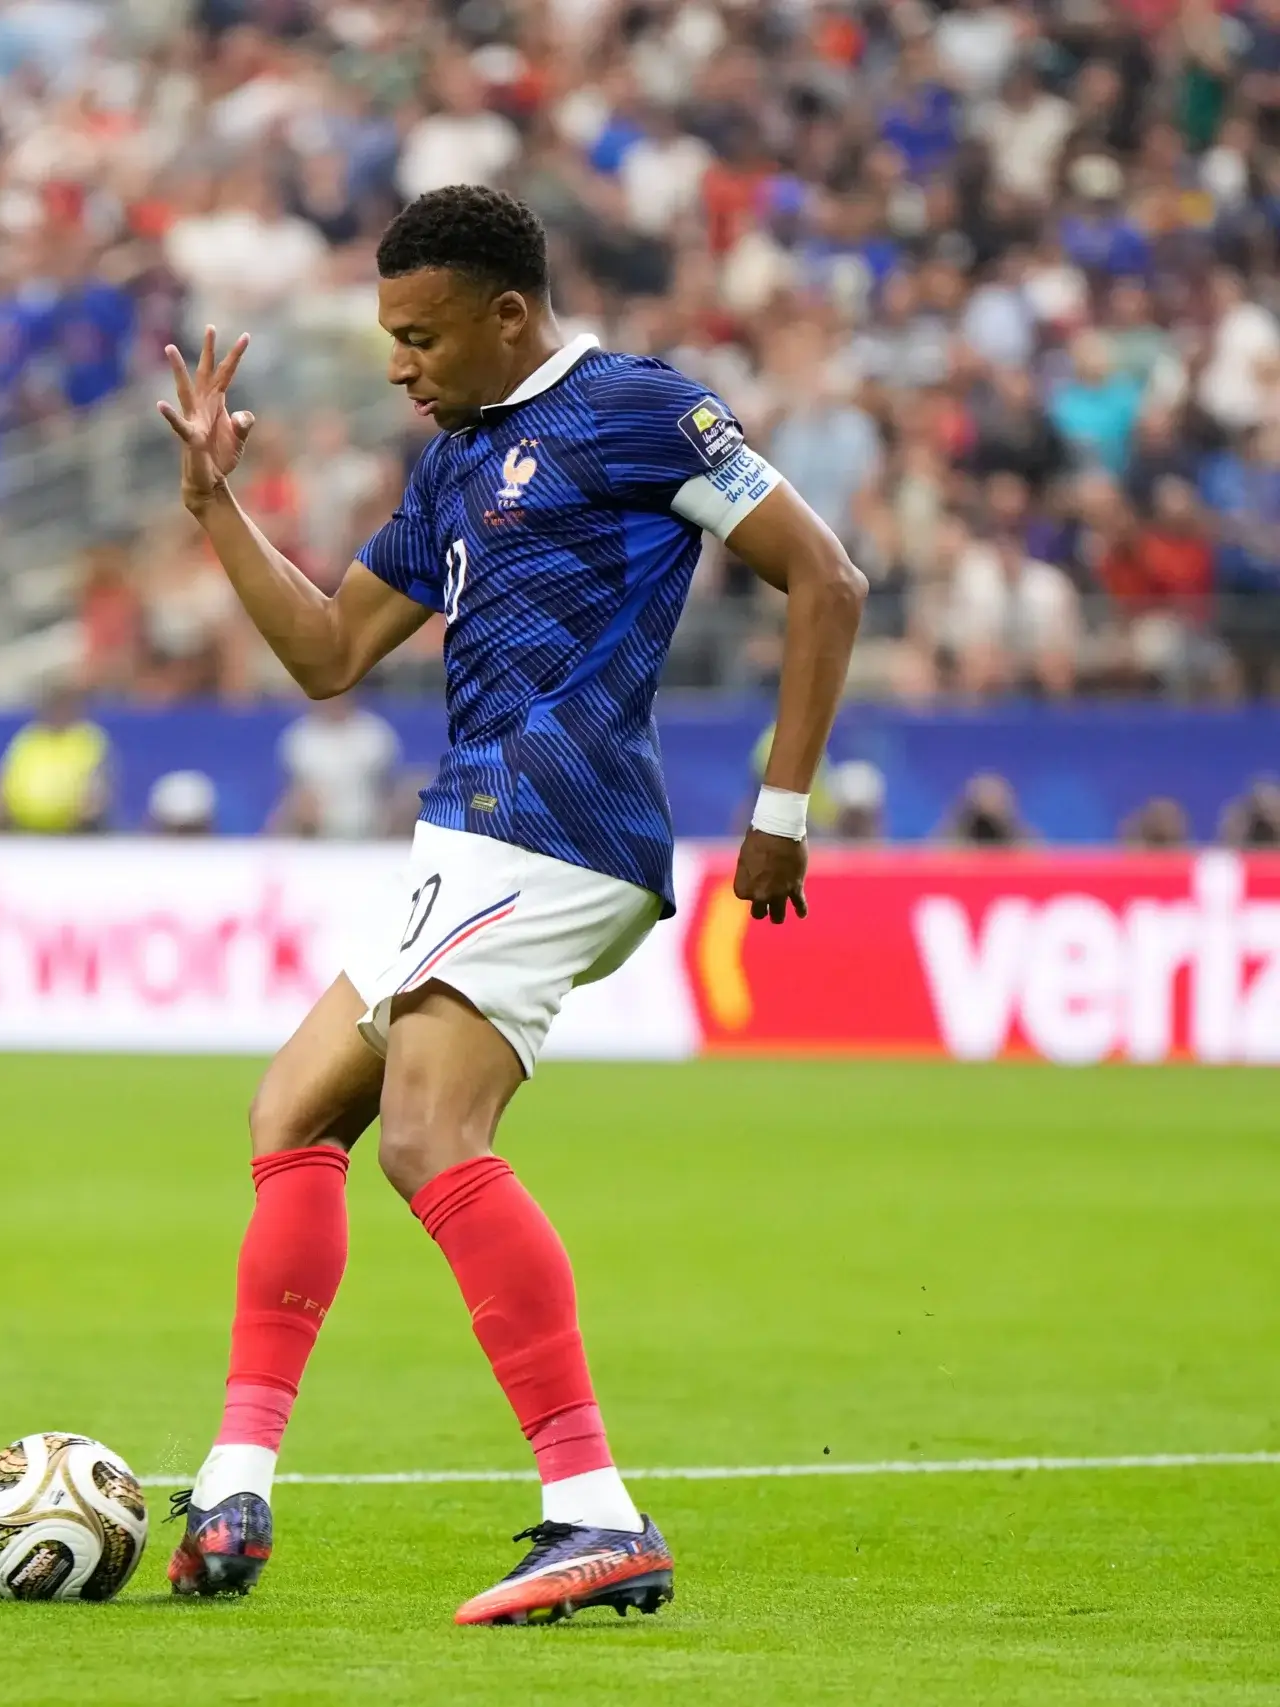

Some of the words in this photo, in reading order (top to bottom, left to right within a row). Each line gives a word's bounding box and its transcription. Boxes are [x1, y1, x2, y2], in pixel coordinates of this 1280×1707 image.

[705, 430, 736, 456] EDUCATI
[711, 451, 754, 492] UNITES
[724, 486, 745, 503] the
[739, 459, 766, 488] World
[749, 480, 769, 500] FIFA
